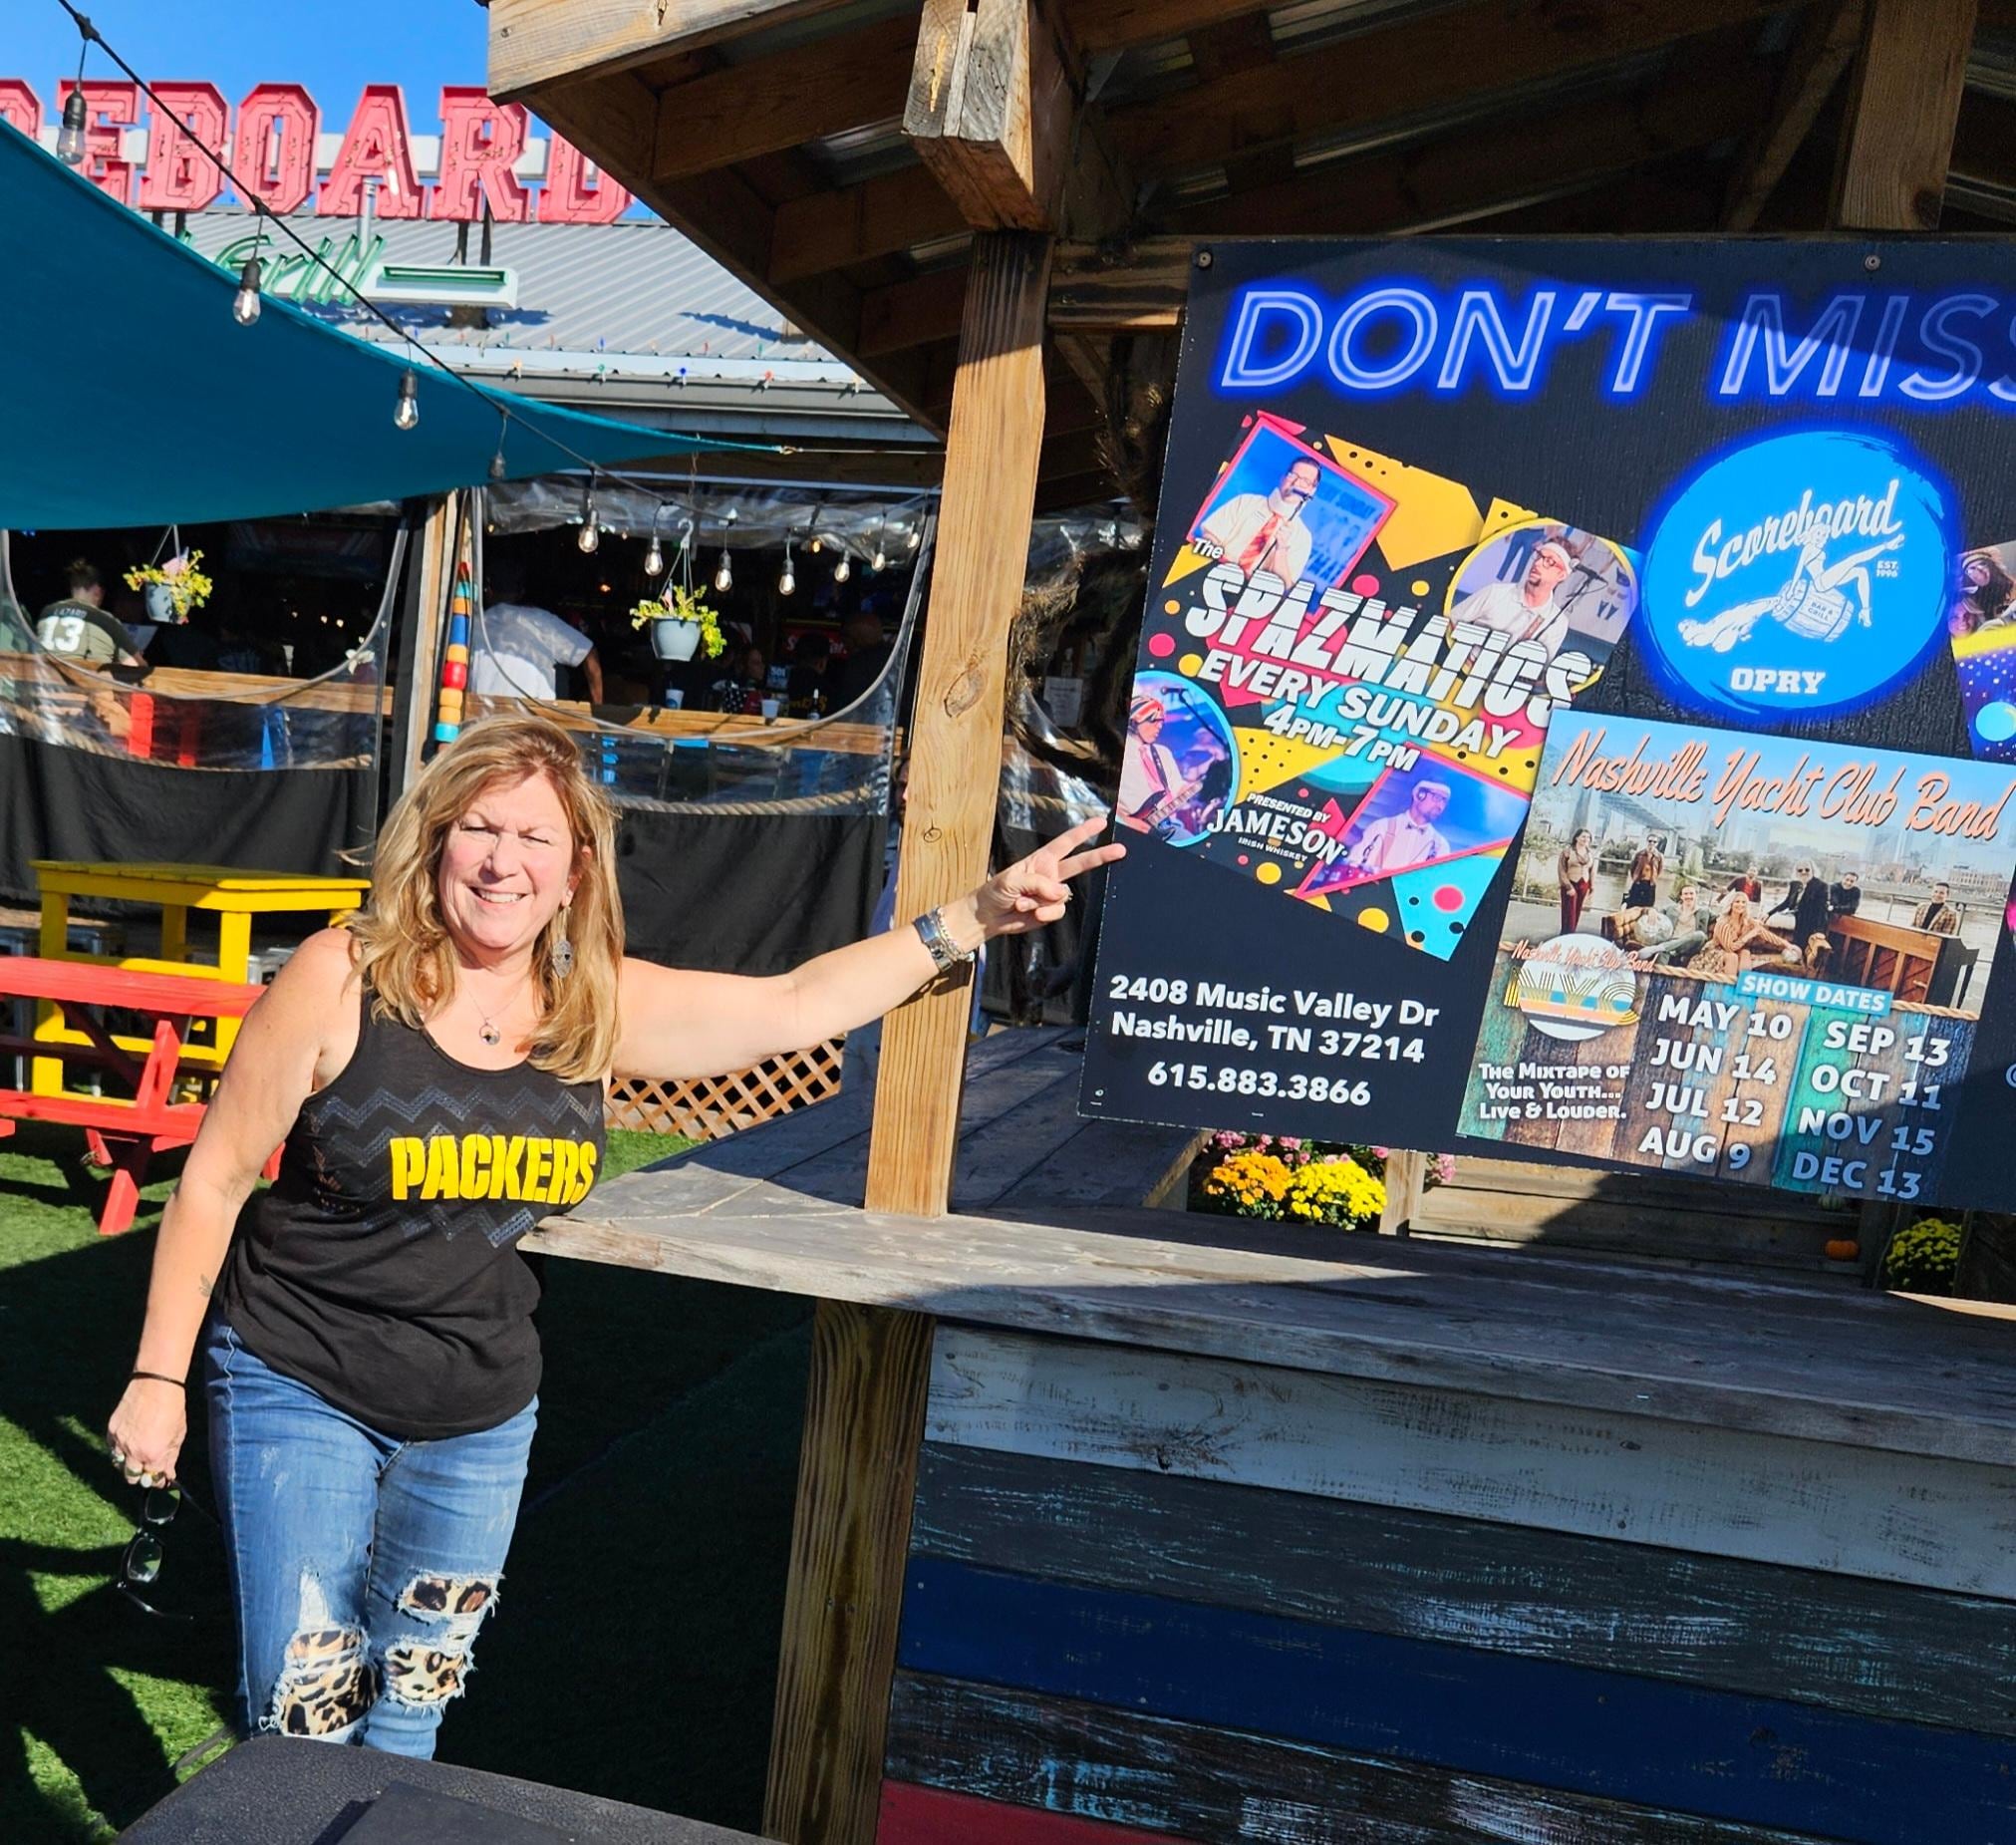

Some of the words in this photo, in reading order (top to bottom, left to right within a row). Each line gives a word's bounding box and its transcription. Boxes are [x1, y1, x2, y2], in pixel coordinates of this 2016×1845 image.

[1222, 288, 1691, 393] DON'T
[1720, 293, 2016, 400] MIS
[1192, 538, 1225, 560] The
[1685, 478, 1904, 607] Scoreboard
[41, 615, 85, 652] 13
[1185, 561, 1592, 729] SPAZMATICS
[1198, 651, 1340, 710] EVERY
[1337, 683, 1522, 759] SUNDAY
[1731, 668, 1826, 695] OPRY
[1264, 703, 1421, 772] 4PM-7PM
[1247, 792, 1312, 822] PRESENTED
[1311, 810, 1331, 824] BY
[1553, 729, 1708, 804] Nashville
[1712, 748, 1825, 827] Yacht
[1821, 763, 1906, 827] Club
[1905, 770, 2016, 841] Band
[1207, 808, 1343, 865] JAMESON
[1239, 837, 1266, 851] IRISH
[1266, 843, 1308, 862] WHISKEY
[1625, 951, 1659, 973] Band
[1109, 975, 1189, 1005] 2408
[1196, 982, 1287, 1014] Music
[1294, 990, 1392, 1030] Valley
[1399, 1000, 1440, 1027] Dr
[1742, 974, 1812, 1001] SHOW
[1816, 986, 1885, 1013] DATES
[1111, 1011, 1259, 1052] Nashville,
[1267, 1025, 1311, 1053] TN
[1318, 1030, 1425, 1064] 37214
[1658, 994, 1741, 1032] MAY
[1748, 1012, 1793, 1041] 10
[1649, 1039, 1723, 1076] JUN
[1732, 1054, 1777, 1085] 14
[1823, 1020, 1894, 1056] SEP
[1904, 1036, 1951, 1067] 13
[1147, 1061, 1371, 1106] 615.883.3866
[1644, 1081, 1709, 1118] JUL
[1720, 1097, 1765, 1127] 12
[1811, 1065, 1890, 1101] OCT
[1898, 1080, 1942, 1111] 11
[1526, 1102, 1543, 1119] &
[1798, 1107, 1882, 1144] NOV
[1890, 1125, 1936, 1156] 15
[390, 1132, 597, 1206] PACKERS
[1638, 1126, 1718, 1164] AUG
[1729, 1143, 1751, 1170] 9
[1793, 1151, 1868, 1189] DEC
[1877, 1169, 1922, 1199] 13
